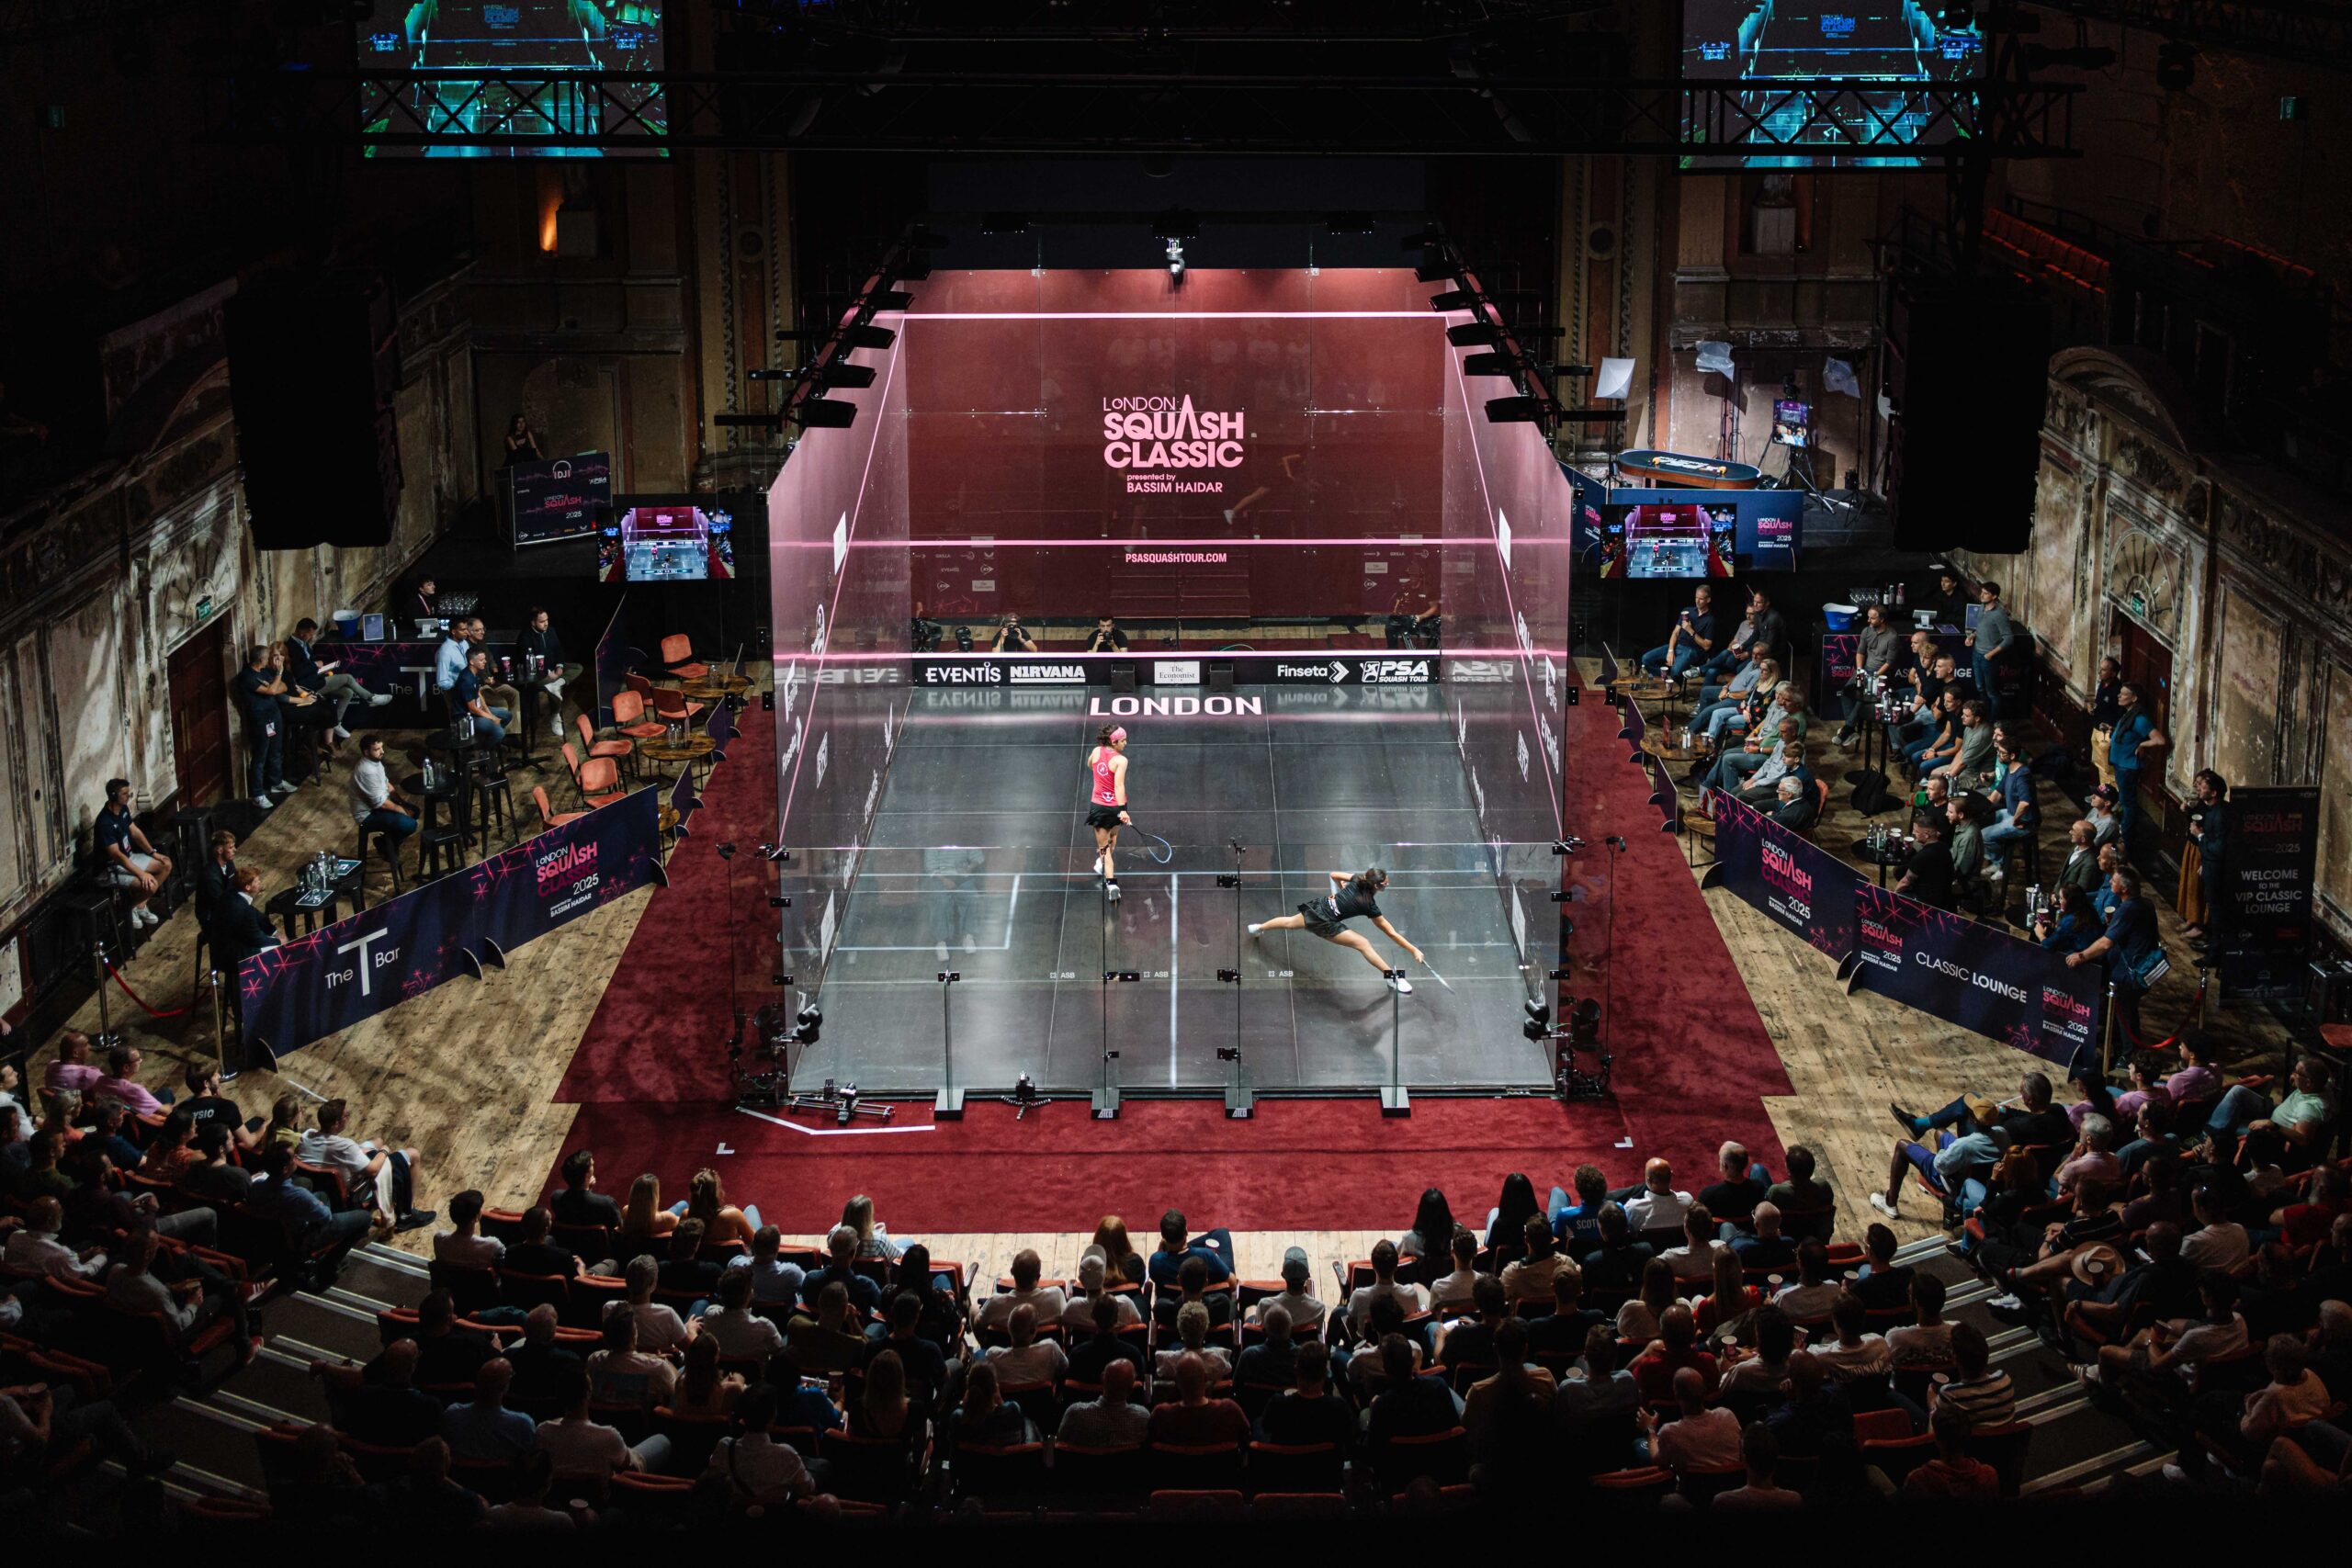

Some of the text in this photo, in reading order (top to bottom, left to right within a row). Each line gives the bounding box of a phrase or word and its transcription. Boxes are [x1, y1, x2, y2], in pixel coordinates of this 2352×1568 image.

[1103, 397, 1176, 411] LONDON
[1103, 394, 1244, 440] SQUASH
[1103, 441, 1244, 468] CLASSIC
[1166, 474, 1176, 482] by
[1127, 482, 1223, 492] BASSIM HAIDAR
[544, 493, 582, 508] SQUASH
[566, 511, 582, 519] 2025
[1758, 517, 1792, 529] SQUASH
[1125, 553, 1227, 563] PSASQUASHTOUR.COM
[926, 661, 1001, 682] EVENTIS
[1011, 665, 1086, 679] NIRVANA
[1170, 665, 1184, 673] The
[1277, 664, 1328, 677] Finseta
[1379, 660, 1430, 675] PSA
[1159, 671, 1196, 680] Economist
[388, 682, 413, 695] The
[400, 666, 437, 712] T
[1090, 696, 1261, 716] LONDON
[2243, 808, 2302, 832] SQUASH
[1762, 838, 1788, 860] LONDON
[2275, 843, 2301, 853] 2025
[536, 846, 569, 867] LONDON
[537, 841, 598, 883] SQUASH
[1762, 848, 1812, 891] SQUASH
[2241, 869, 2299, 881] WELCOME
[537, 859, 598, 897] CLASSIC
[572, 873, 599, 895] 2025
[1761, 865, 1811, 905] CLASSIC
[571, 893, 592, 908] HAIDAR
[2234, 890, 2302, 902] VIP CLASSIC
[1788, 896, 1811, 919] 2025
[2245, 902, 2291, 914] LOUNGE
[1861, 919, 1883, 931] LONDON
[1861, 924, 1903, 947] SQUASH
[324, 927, 401, 997] The T Bar
[1883, 950, 1902, 964] 2025
[1916, 952, 2028, 1004] CLASSIC LOUNGE
[2043, 986, 2068, 998] LONDON
[2043, 991, 2090, 1017] SQUASH
[2067, 1021, 2088, 1034] 2025
[193, 1108, 215, 1120] YSIO
